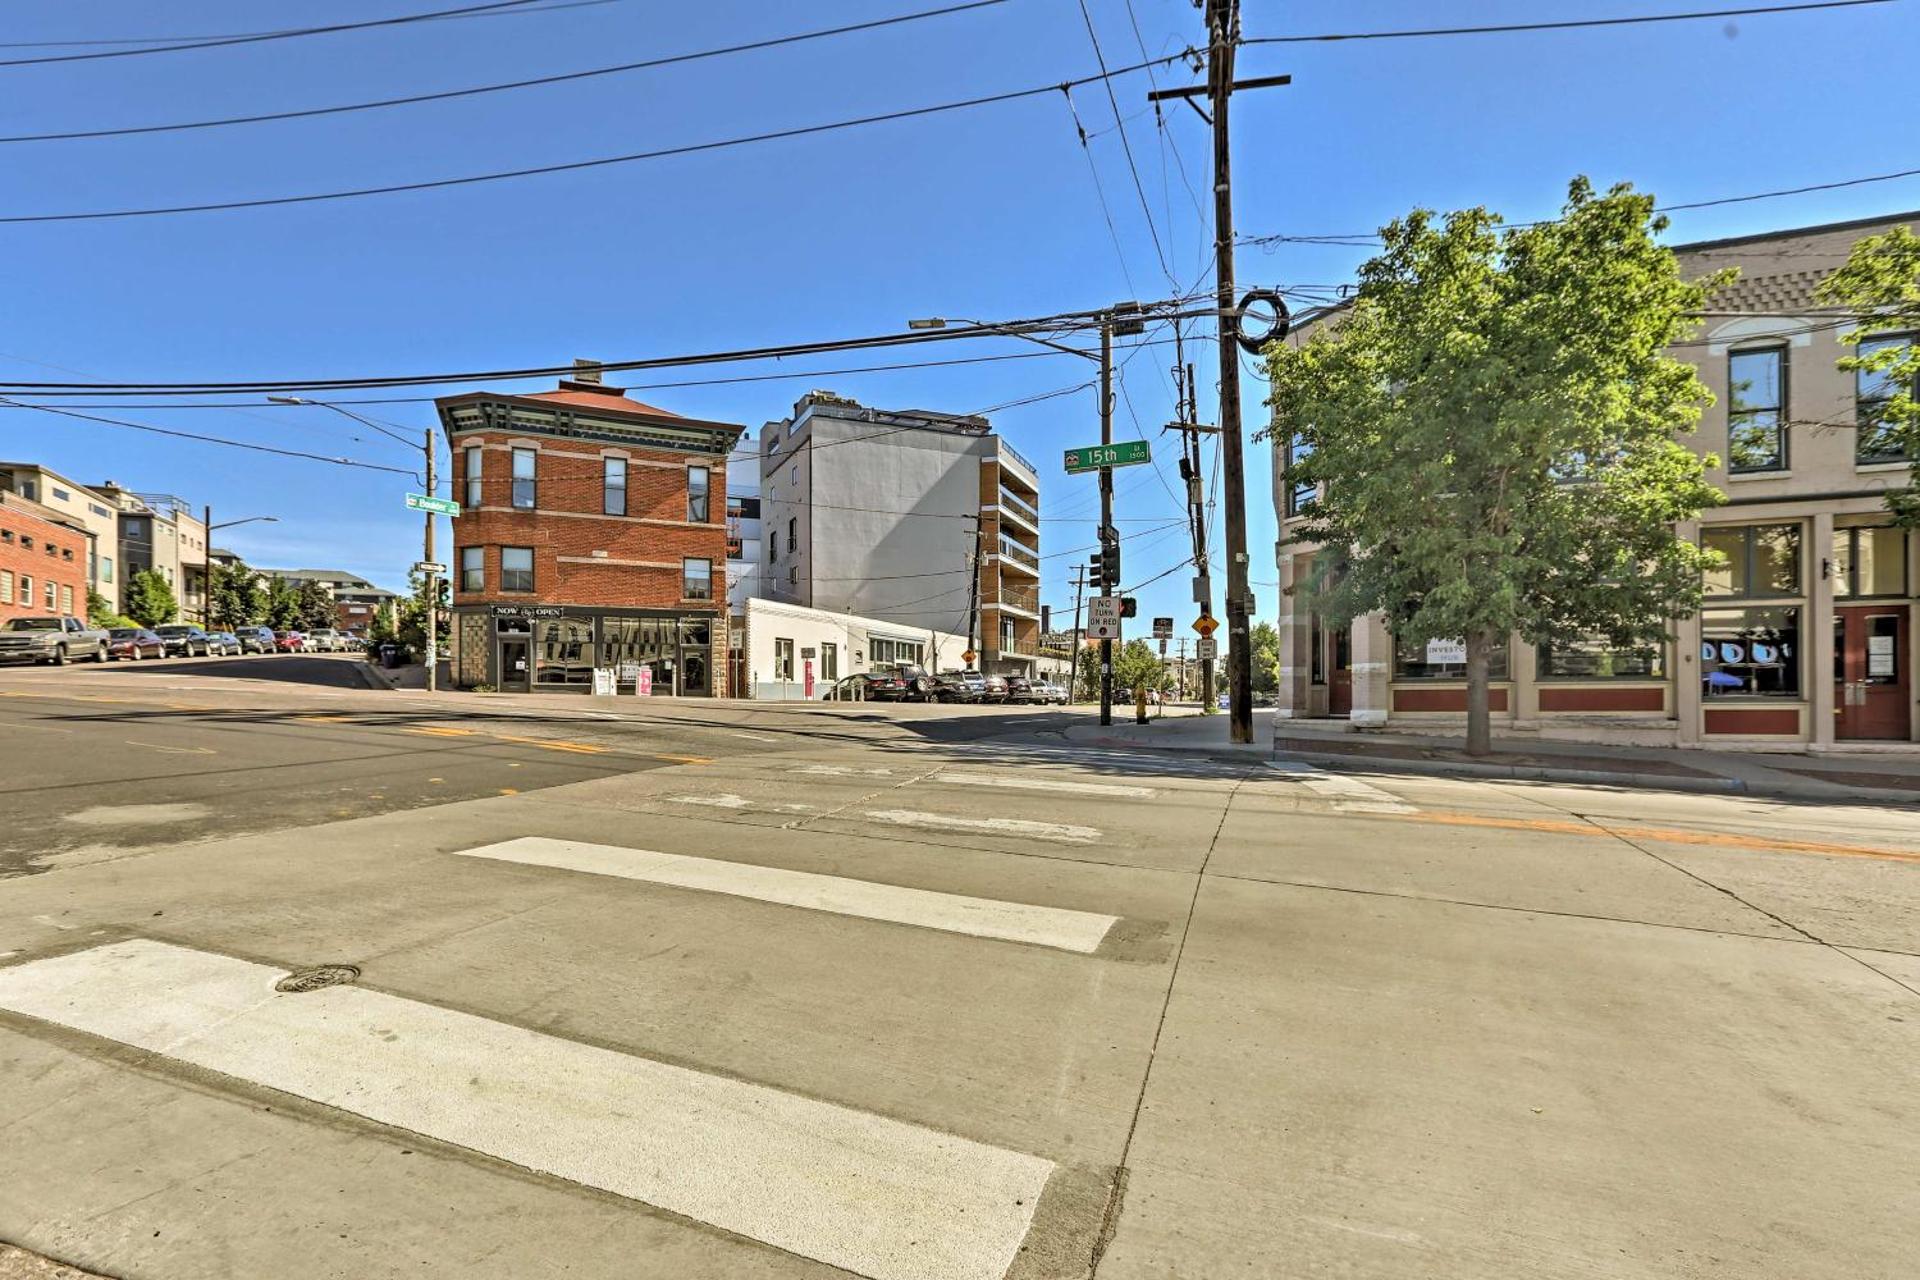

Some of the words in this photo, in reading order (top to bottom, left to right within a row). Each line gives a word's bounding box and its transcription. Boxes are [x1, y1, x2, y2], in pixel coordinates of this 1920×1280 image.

[1088, 449, 1117, 464] 15th
[1097, 599, 1111, 608] NO
[535, 607, 560, 615] OPEN
[1090, 617, 1100, 625] ON
[1103, 617, 1117, 625] RED
[1428, 645, 1466, 654] INVESTO
